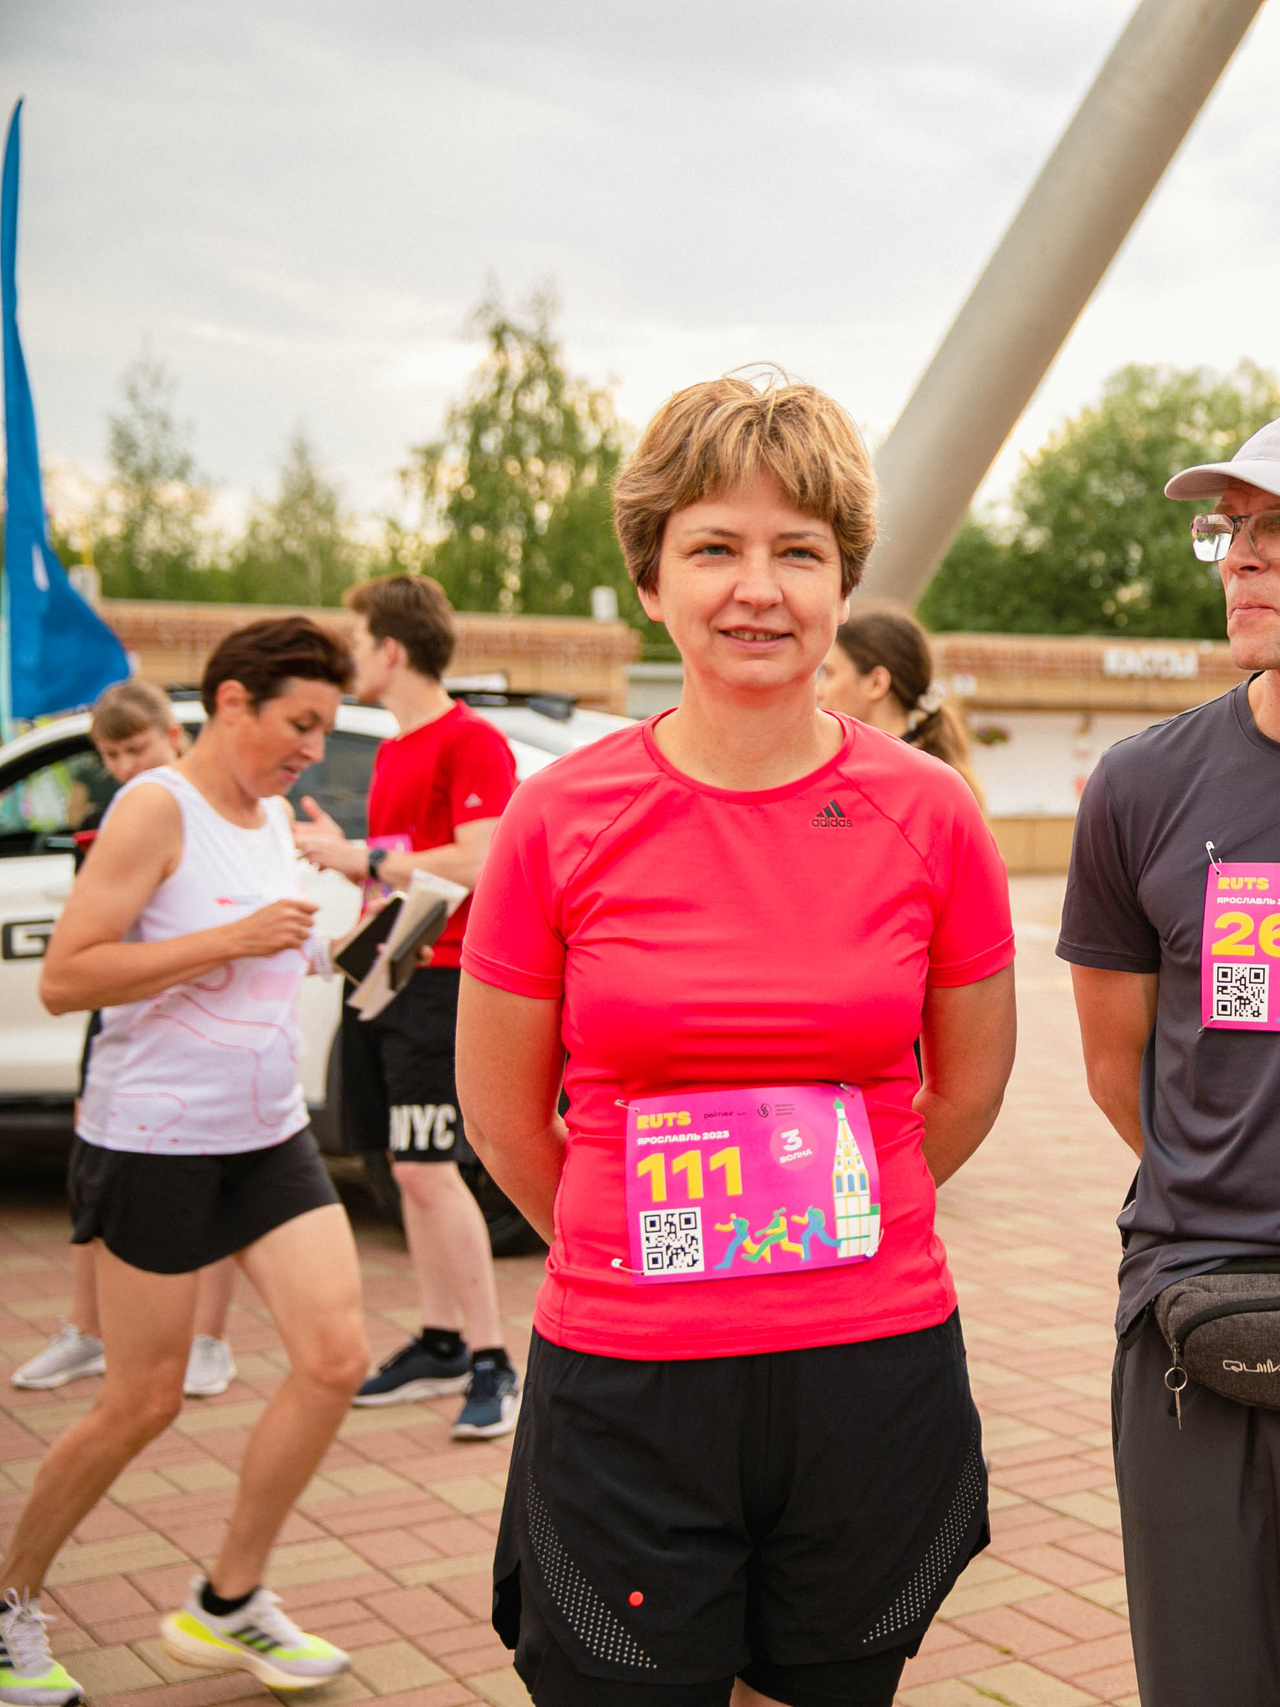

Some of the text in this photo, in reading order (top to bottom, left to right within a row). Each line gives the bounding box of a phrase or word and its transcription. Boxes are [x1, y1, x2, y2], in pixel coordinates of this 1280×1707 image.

[811, 817, 853, 828] adidas
[1217, 877, 1269, 890] RUTS
[1217, 897, 1276, 905] ЯРОСЛАВЛЬ
[389, 1104, 457, 1151] NYC
[637, 1111, 691, 1130] RUTS
[637, 1130, 730, 1146] ЯРОСЛАВЛЬ 2023
[781, 1128, 803, 1152] 3
[779, 1148, 813, 1164] ВОЛНА
[637, 1146, 743, 1203] 111
